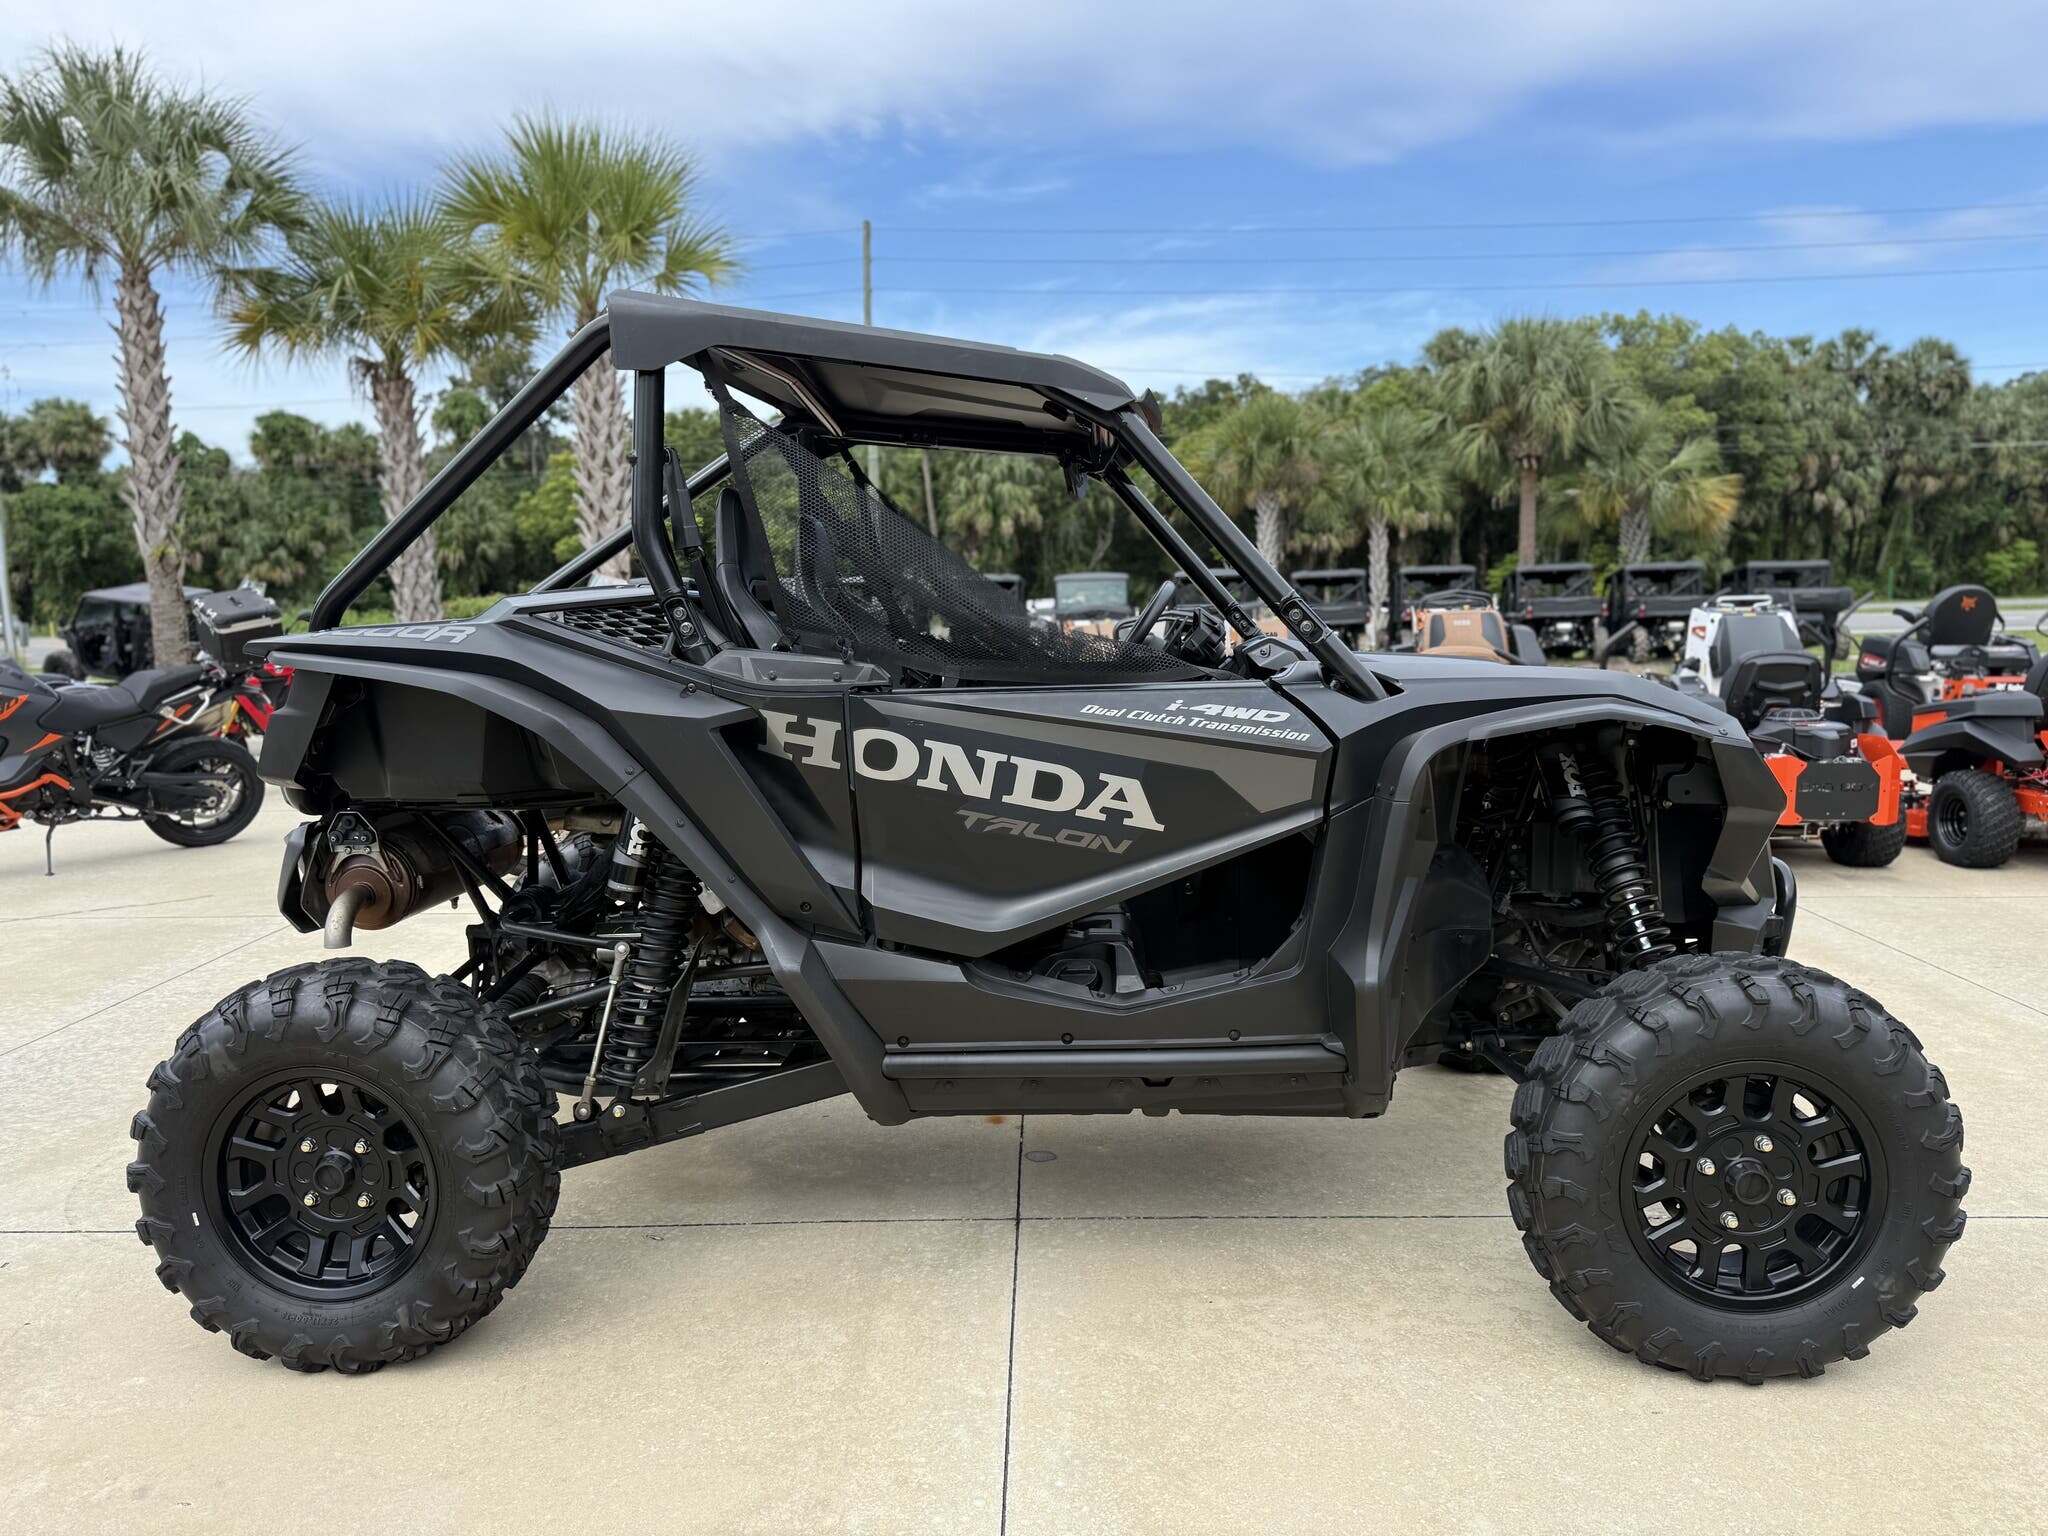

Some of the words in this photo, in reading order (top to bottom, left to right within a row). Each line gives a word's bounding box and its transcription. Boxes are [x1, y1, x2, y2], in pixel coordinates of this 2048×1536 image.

[1080, 704, 1127, 718] Dual
[1127, 709, 1187, 726] Clutch
[1188, 717, 1311, 742] Transmission
[1164, 699, 1292, 723] i-4WD
[757, 709, 1166, 832] HONDA
[954, 809, 1134, 855] TALON
